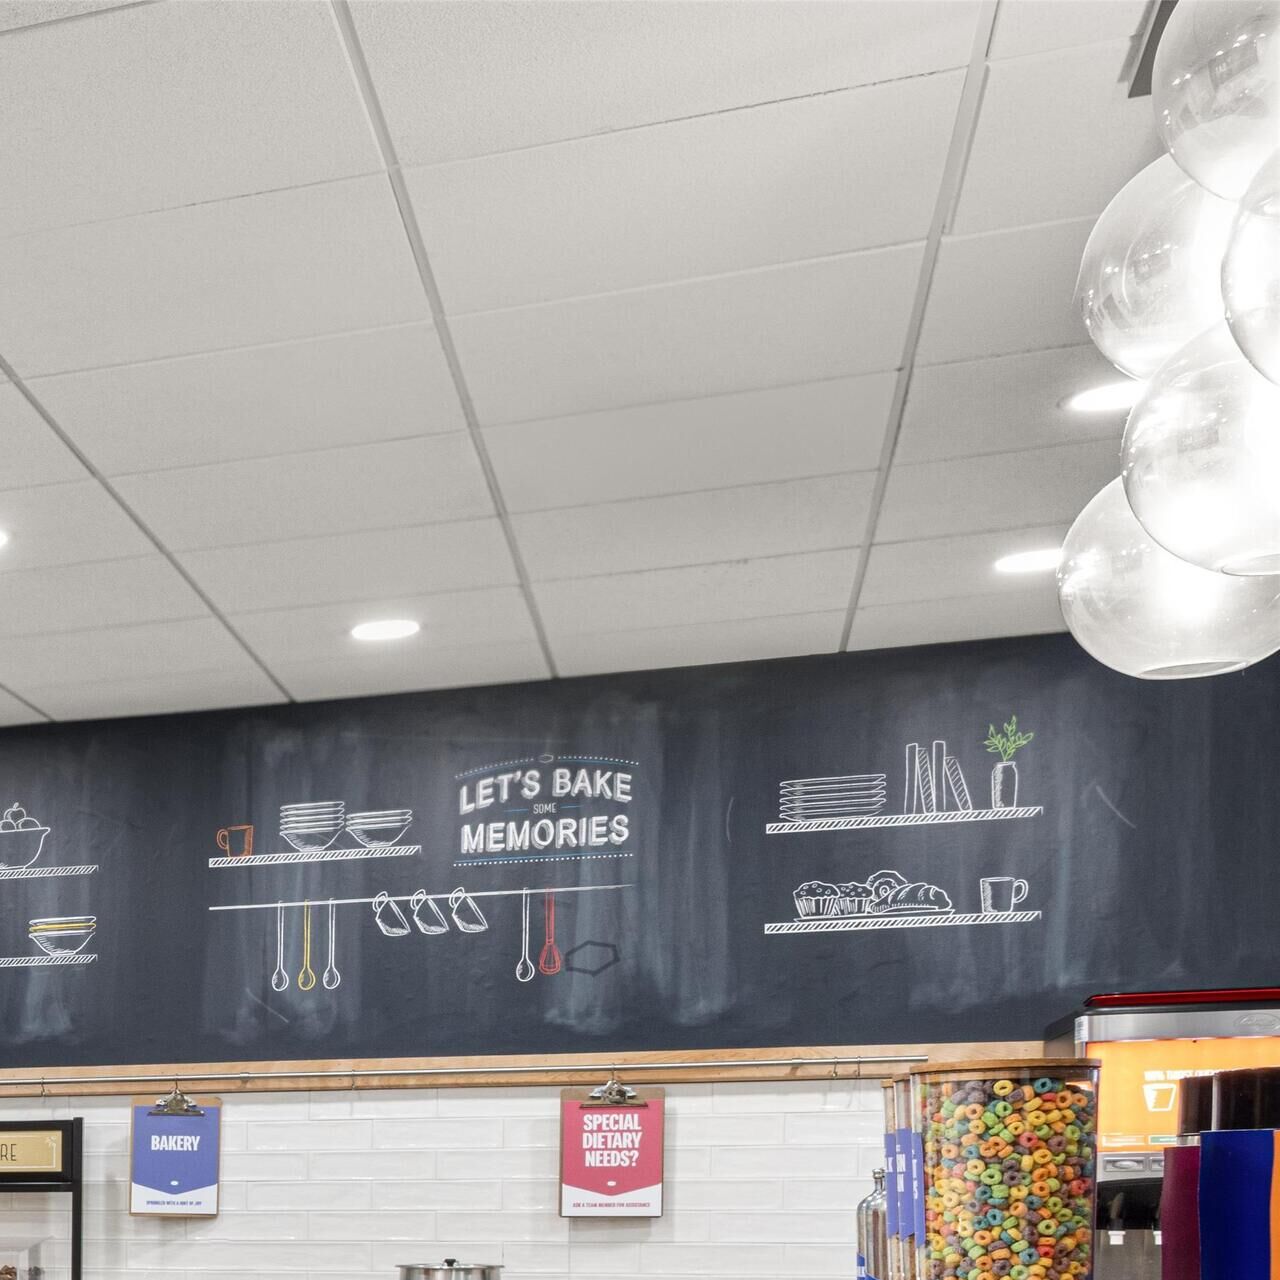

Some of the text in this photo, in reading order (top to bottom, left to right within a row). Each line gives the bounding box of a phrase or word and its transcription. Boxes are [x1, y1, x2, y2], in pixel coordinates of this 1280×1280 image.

[459, 768, 633, 815] LET'S BAKE
[533, 803, 557, 814] SOME
[460, 815, 630, 854] MEMORIES
[583, 1114, 642, 1131] SPECIAL
[151, 1135, 201, 1151] BAKERY
[582, 1132, 643, 1149] DIETARY
[585, 1150, 639, 1167] NEEDS?
